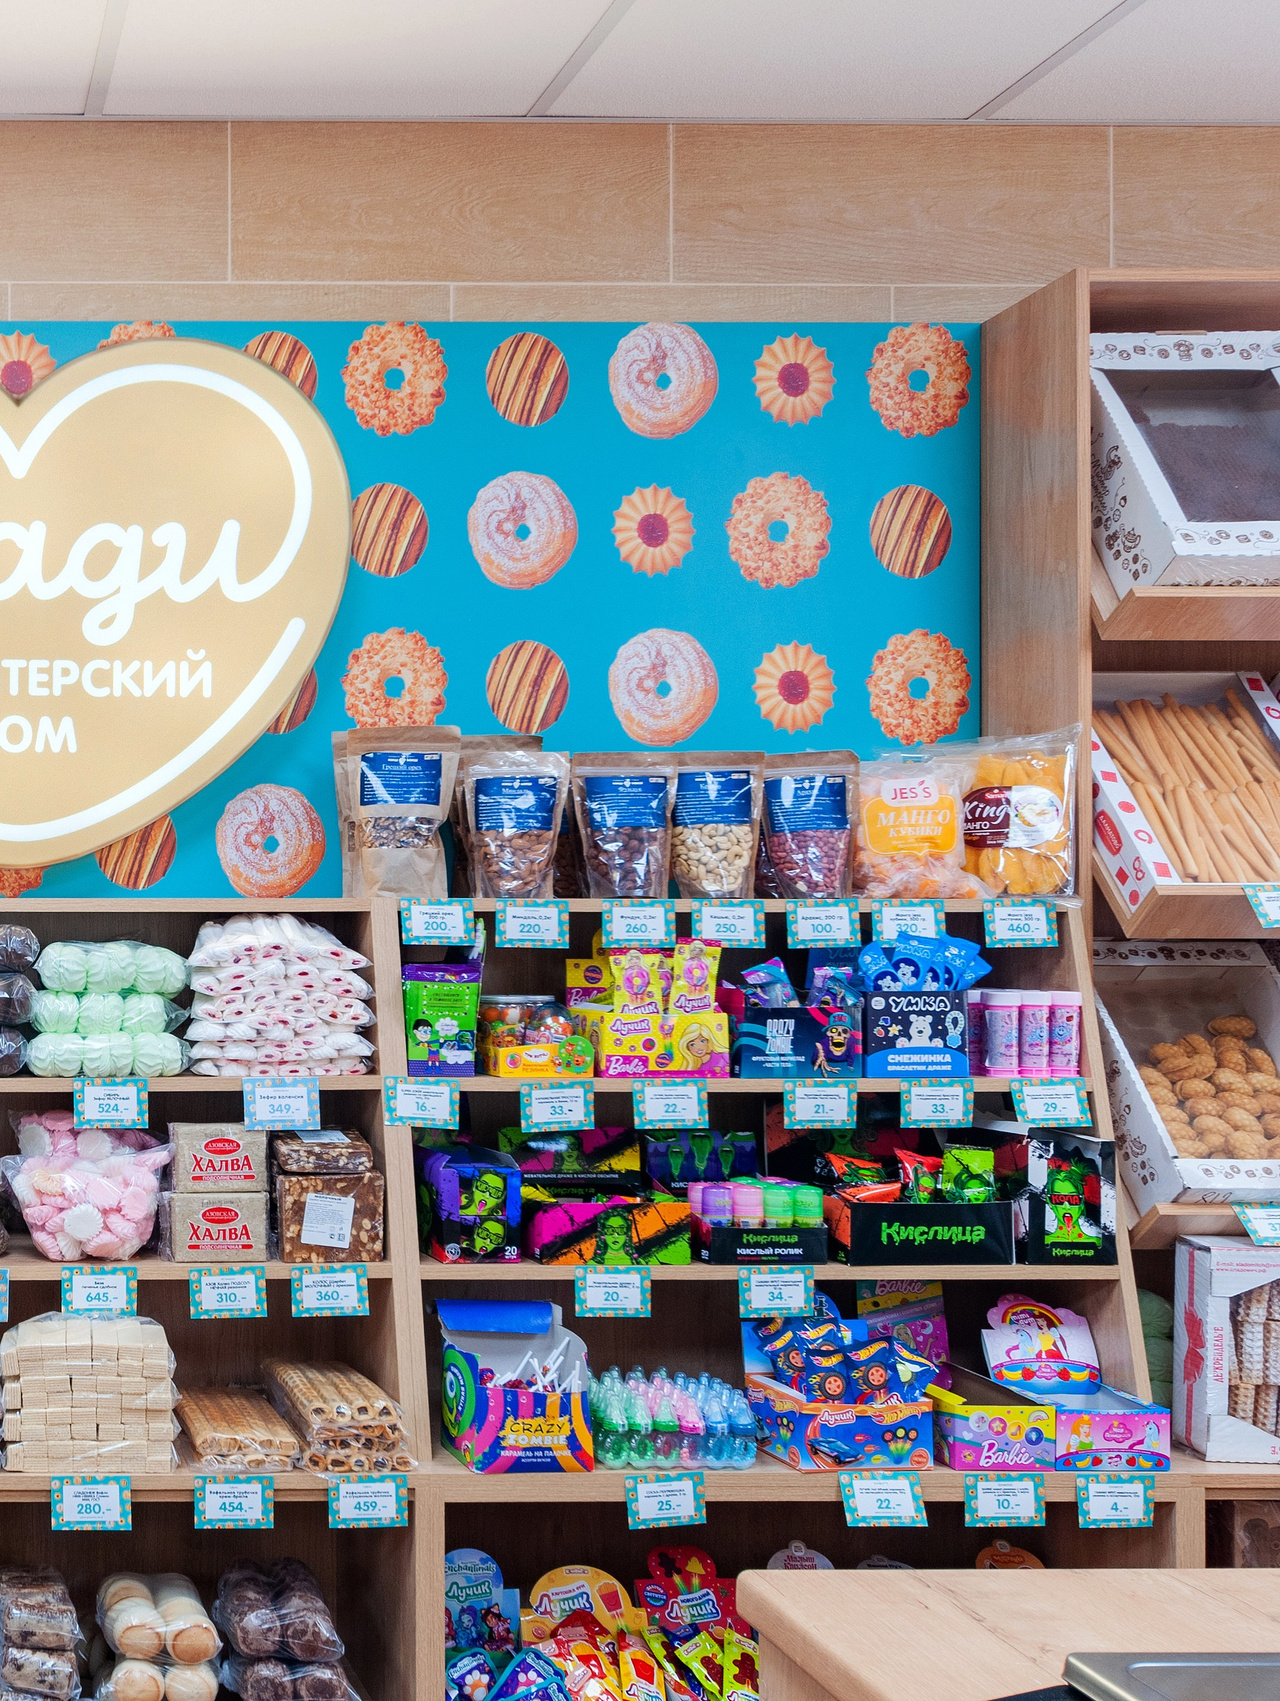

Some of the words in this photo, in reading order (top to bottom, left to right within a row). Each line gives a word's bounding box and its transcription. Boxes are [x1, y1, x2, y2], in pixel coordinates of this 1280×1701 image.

[877, 809, 950, 828] МАНГО
[888, 826, 942, 838] КУБИКИ
[889, 996, 951, 1013] УМКА
[611, 1019, 649, 1034] Лучик
[766, 1019, 795, 1037] CRAZY
[608, 1055, 648, 1075] Barbie
[887, 1054, 952, 1063] СНЕЖИНКА
[191, 1153, 254, 1173] ХАЛВА
[188, 1220, 252, 1242] ХАЛВА
[742, 1233, 799, 1245] Кислица
[881, 1222, 986, 1247] Кислица
[505, 1246, 518, 1256] 20
[737, 1247, 773, 1255] КИСЛЫЙ
[1052, 1248, 1094, 1257] Кислица
[875, 1277, 927, 1296] Barbie
[820, 1410, 855, 1424] Лучик
[509, 1422, 565, 1434] CRAZY
[507, 1434, 568, 1446] ZOMBIE
[979, 1440, 1035, 1468] Barbie
[444, 1562, 496, 1574] Enchantimals
[447, 1580, 491, 1600] Лучик
[538, 1591, 591, 1617] Лучик
[670, 1599, 718, 1622] Лучик
